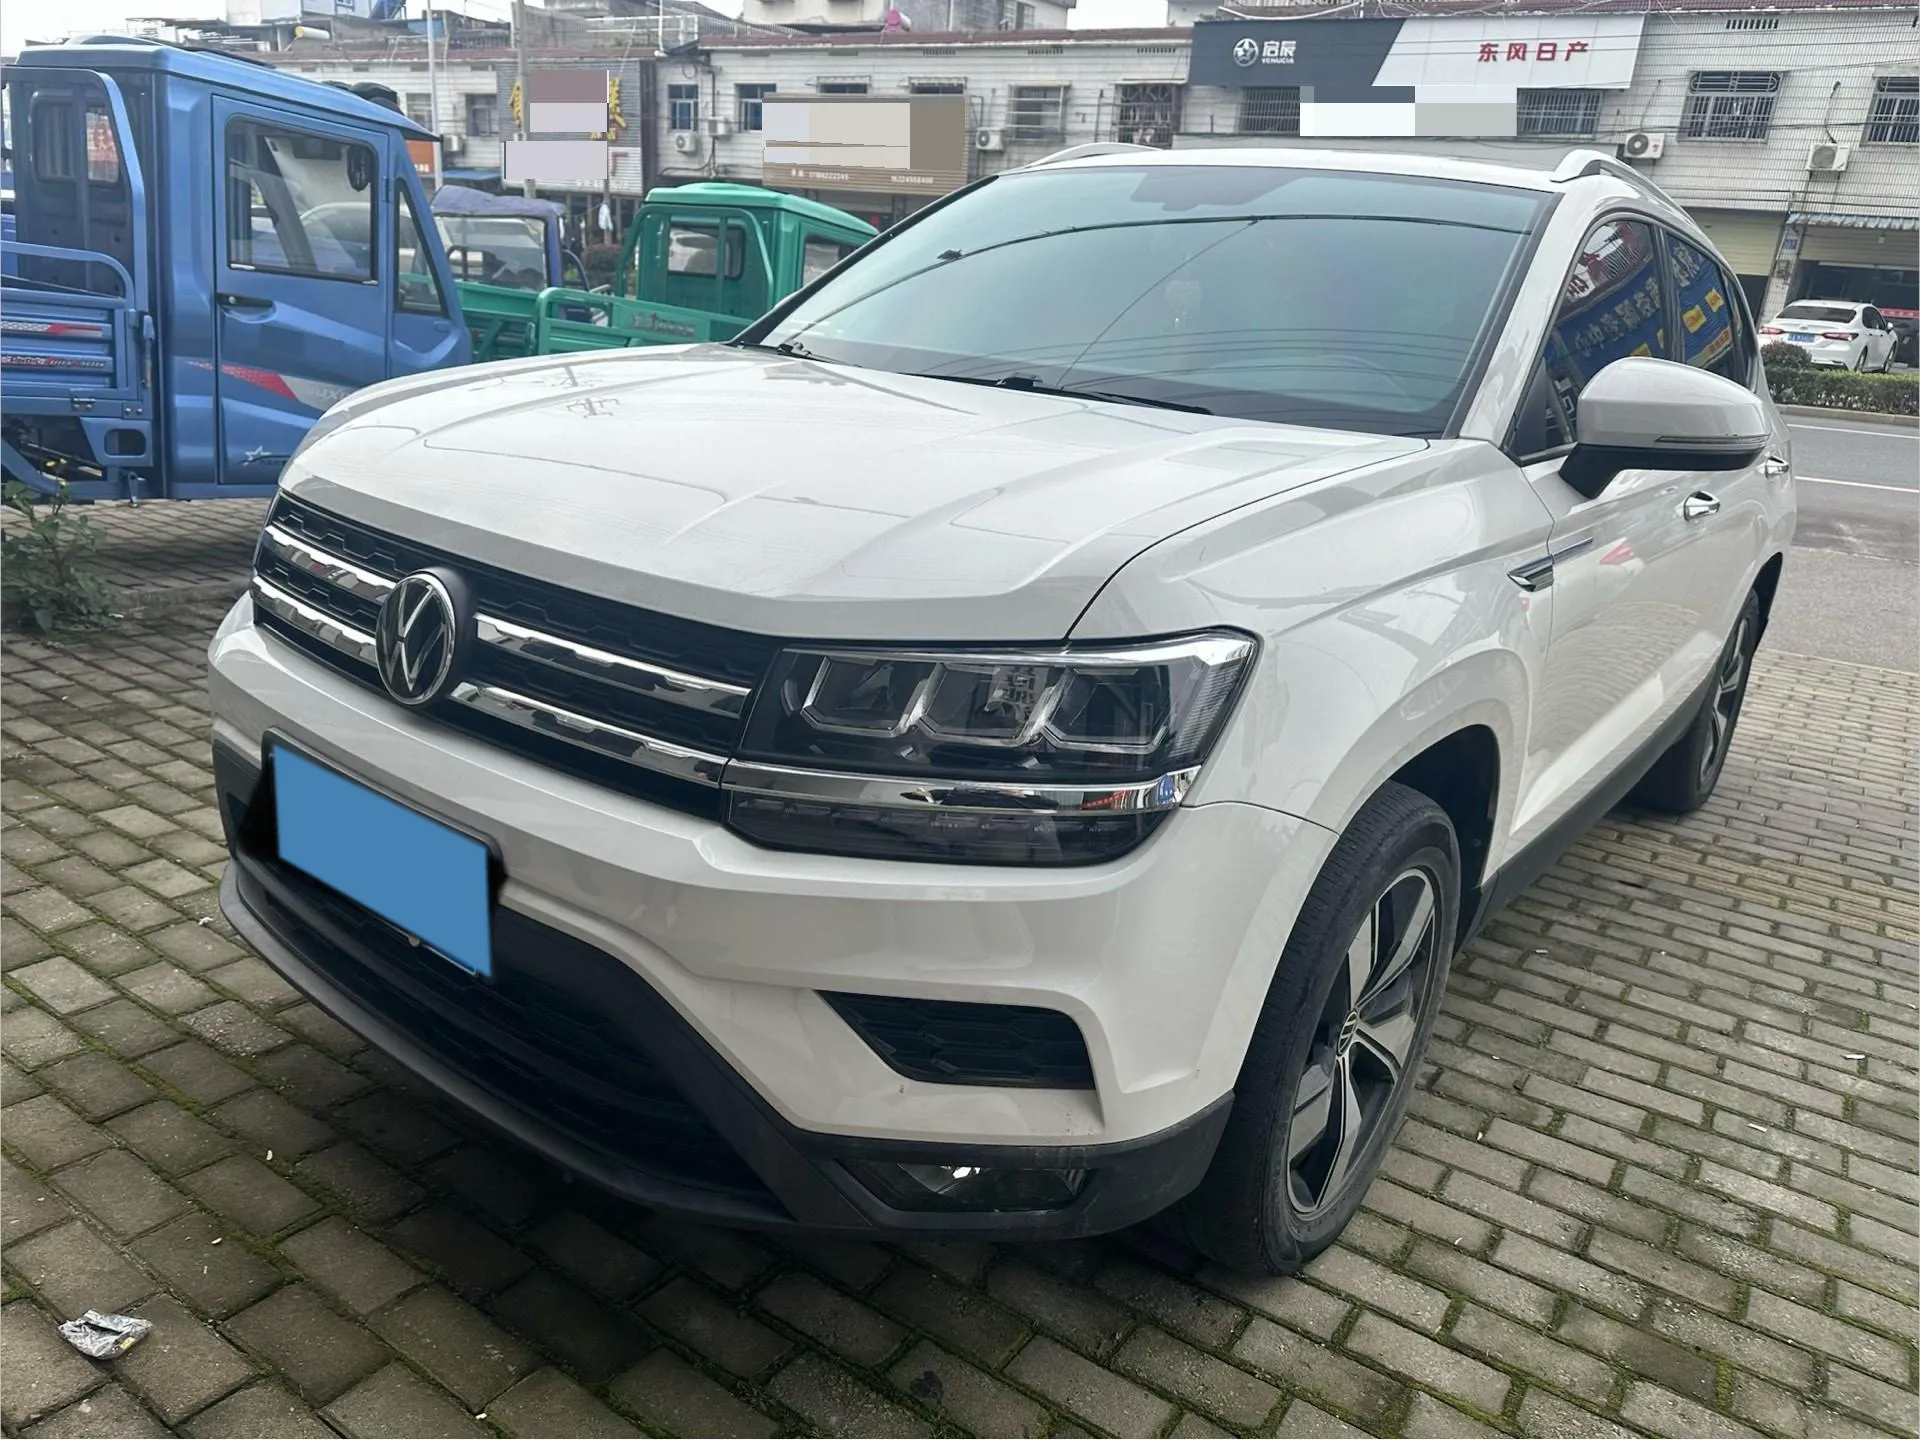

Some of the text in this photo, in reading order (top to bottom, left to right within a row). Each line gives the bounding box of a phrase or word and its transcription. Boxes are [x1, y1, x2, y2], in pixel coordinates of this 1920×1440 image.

[1262, 40, 1297, 57] 启辰
[1477, 40, 1589, 62] 东风日产
